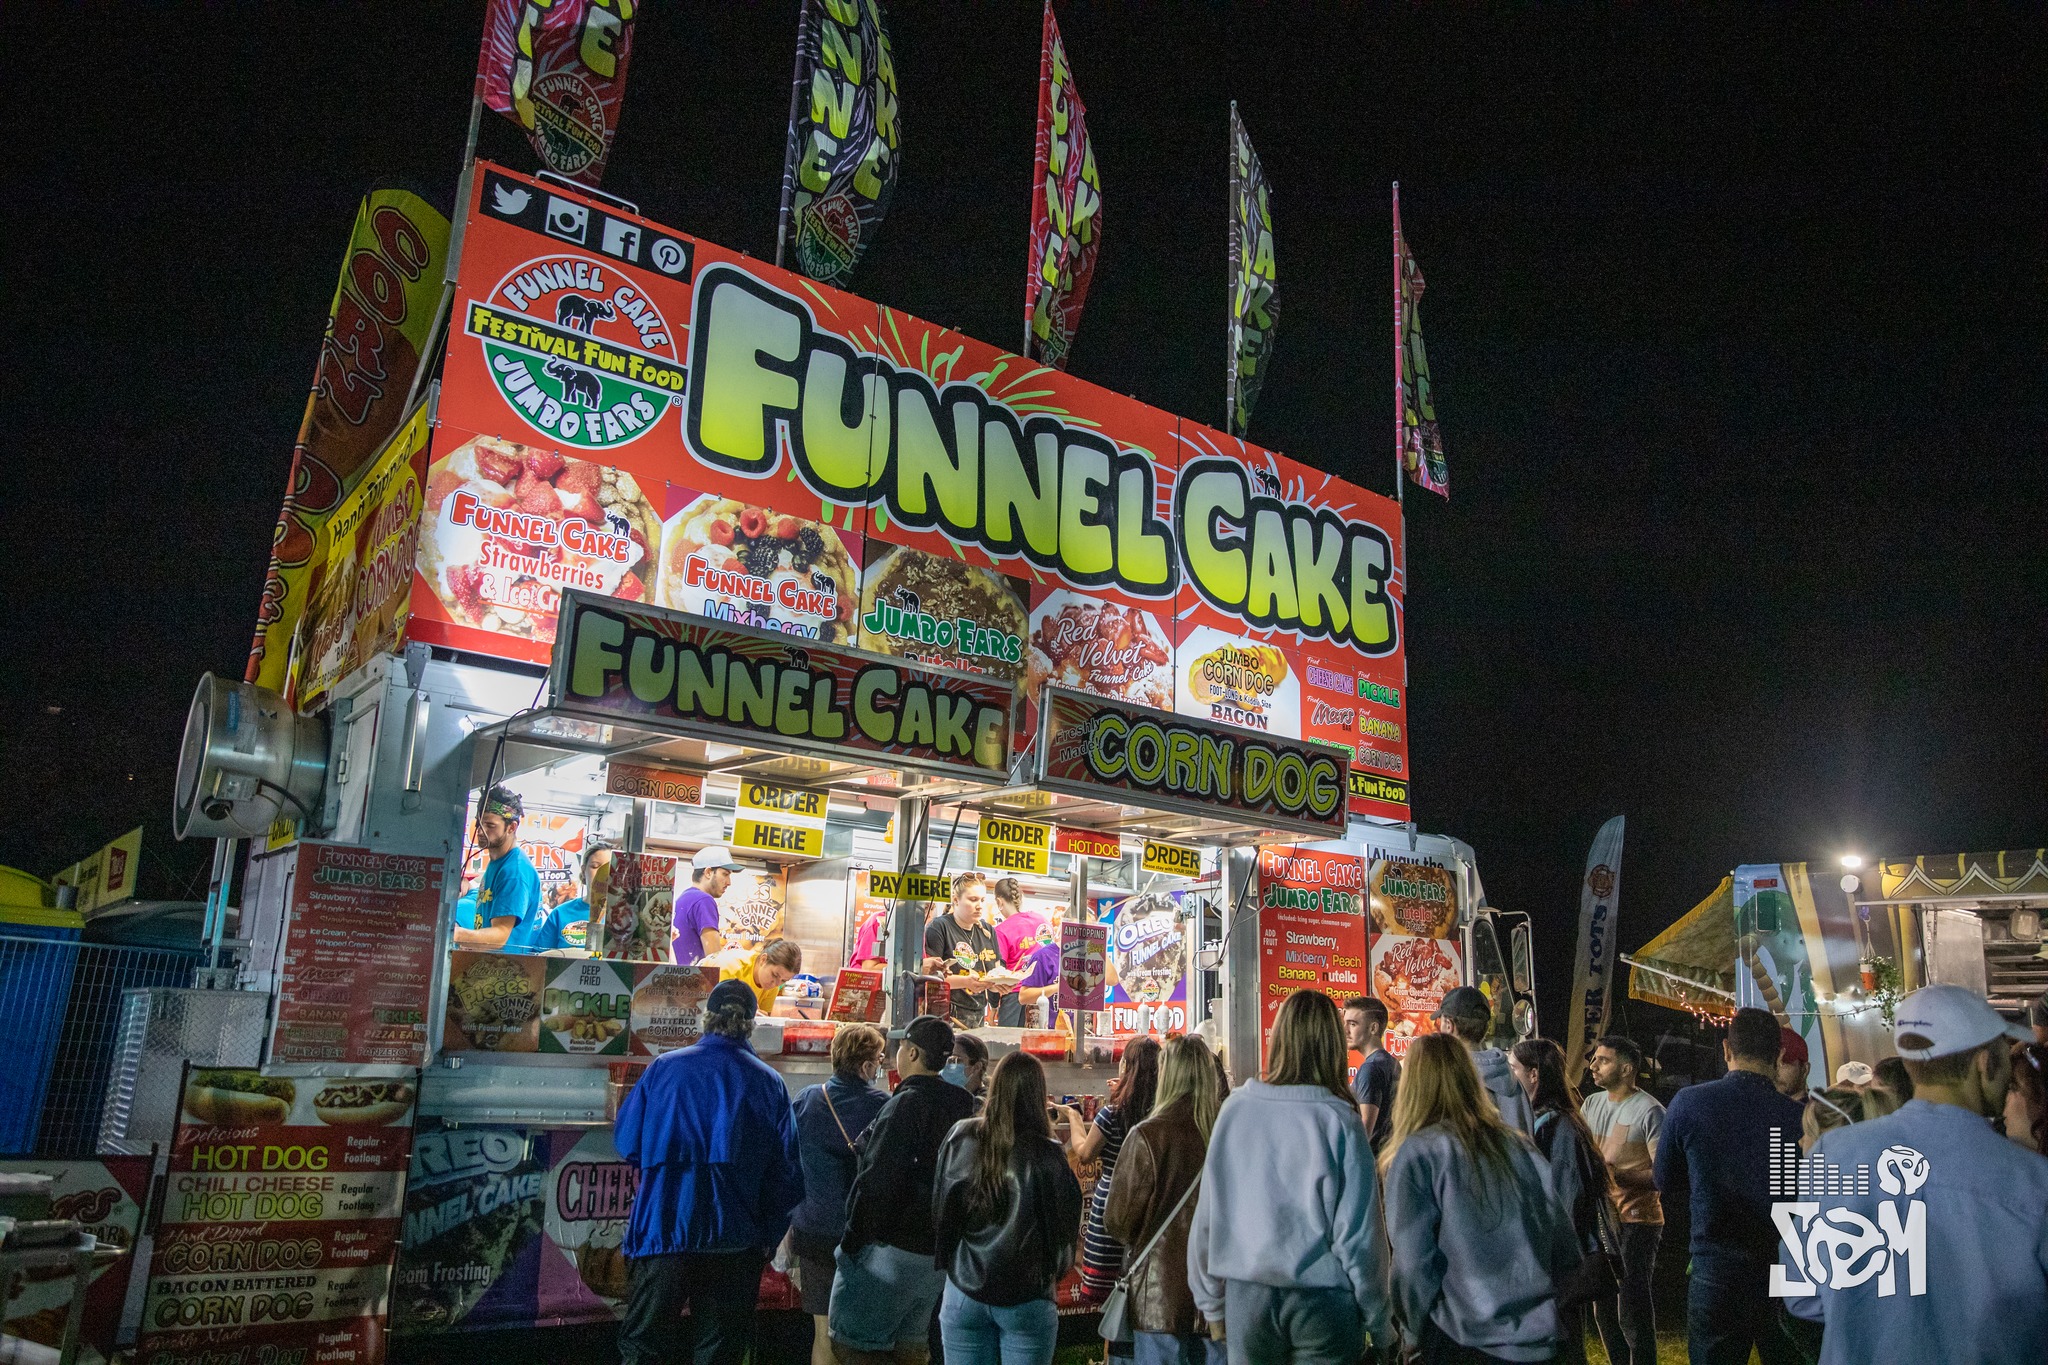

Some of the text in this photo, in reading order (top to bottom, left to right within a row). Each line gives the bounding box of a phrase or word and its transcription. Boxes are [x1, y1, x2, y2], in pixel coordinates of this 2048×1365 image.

[539, 76, 584, 97] FUNNEL
[585, 96, 603, 131] CAKE
[502, 260, 669, 350] FUNNEL CAKE
[473, 307, 685, 391] FESTIVAL FUN FOOD
[493, 353, 657, 444] JUMBO EARS
[690, 270, 1173, 592] FUNNEL
[1180, 460, 1397, 650] CAKE
[333, 494, 366, 548] Hand
[371, 477, 416, 554] JUMBO
[451, 491, 631, 563] FUNNEL CAKE
[480, 541, 604, 590] Strawberries
[356, 538, 396, 624] CORN
[480, 574, 496, 602] &
[503, 577, 527, 606] Ice
[685, 554, 836, 619] FUNNEL CAKE
[863, 598, 1022, 664] JUMBO EARS
[1055, 615, 1100, 645] Red
[1079, 640, 1146, 668] Velvet
[1220, 648, 1259, 670] JUMBO
[1089, 660, 1154, 684] Funnel Cake
[1203, 658, 1274, 696] CORN DOG
[1307, 666, 1354, 696] CHEESE CAKE
[570, 609, 1006, 768] FUNNEL CAKE
[1210, 684, 1238, 701] FOOT-LONG
[1358, 678, 1400, 709] PICKLE
[1211, 703, 1268, 730] BACON
[1311, 701, 1354, 726] Mars
[1055, 717, 1102, 745] Freshly
[1359, 716, 1401, 742] BANANA
[1059, 736, 1100, 763] Made!
[1358, 747, 1383, 769] CORN
[1384, 750, 1403, 773] DOG
[1090, 713, 1340, 817] CORN DOG
[612, 774, 700, 803] CORN DOG
[750, 784, 820, 814] ORDER
[1358, 777, 1406, 801] FUN FOOD
[753, 824, 807, 852] HERE
[986, 820, 1043, 846] ORDER
[318, 846, 427, 874] FUNNEL CAKE
[992, 847, 1035, 870] HERE
[1069, 838, 1120, 858] HOT DOG
[1144, 843, 1200, 870] ORDER
[313, 865, 377, 887] JUMBO
[379, 870, 427, 891] EARS
[1174, 867, 1185, 875] YOUR
[1185, 869, 1200, 877] SERVER
[1262, 850, 1363, 889] FUNNEL CAKE
[309, 891, 359, 904] Strawberry,
[870, 874, 950, 898] PAY HERE
[1380, 875, 1446, 903] JUMBO EARS
[1265, 883, 1363, 915] JUMBO EARS
[736, 904, 778, 921] FUNNEL
[742, 915, 772, 930] CAKE
[1397, 907, 1432, 922] nutella
[1064, 926, 1077, 936] ANY
[1079, 928, 1105, 940] TOPPING
[1118, 918, 1175, 948] OREO
[1263, 938, 1278, 946] FRUIT
[1265, 929, 1276, 937] ADD
[1286, 931, 1339, 951] Strawberry,
[1132, 932, 1182, 966] FUNNEL CAKE
[1286, 950, 1362, 969] Mixberry, Peach
[1392, 938, 1414, 963] Red
[581, 965, 600, 975] DEEP
[663, 967, 691, 975] JUMBO
[1063, 957, 1086, 972] CHEESE
[1152, 967, 1171, 977] Frosting
[1278, 966, 1358, 984] Banana, nutella
[1405, 951, 1437, 976] Velvet
[377, 971, 427, 983] CORN DOG
[579, 976, 601, 986] FRIED
[652, 974, 700, 988] CORN DOG
[1410, 975, 1431, 985] Funnel
[300, 1009, 349, 1020] BANANA
[493, 998, 535, 1013] FUNNEL
[499, 1008, 530, 1022] CAKE
[543, 988, 631, 1019] PICKLE
[651, 1006, 698, 1017] BACON
[1268, 1000, 1279, 1011] HOT
[364, 1030, 421, 1039] PIZZA EAR
[479, 1024, 522, 1033] Peanut Butter
[648, 1026, 698, 1037] CORN DOG
[280, 1044, 320, 1056] JUMBO
[179, 1126, 259, 1145] Delicious
[347, 1136, 380, 1149] Regular
[191, 1145, 329, 1171] HOT DOG
[344, 1152, 381, 1165] Footlong
[178, 1176, 335, 1192] CHILI CHEESE
[341, 1183, 374, 1196] Regular
[477, 1172, 542, 1216] CAKE
[182, 1191, 324, 1221] HOT DOG
[338, 1200, 375, 1213] Footlong
[334, 1230, 368, 1243] Regular
[164, 1238, 323, 1275] CORN DOG
[331, 1247, 369, 1260] Footlong
[433, 1260, 491, 1286] Frosting
[156, 1275, 317, 1296] BACON BATTERED
[155, 1291, 315, 1328] CORN DOG
[318, 1331, 353, 1344] Regular
[316, 1348, 356, 1362] Footlong
